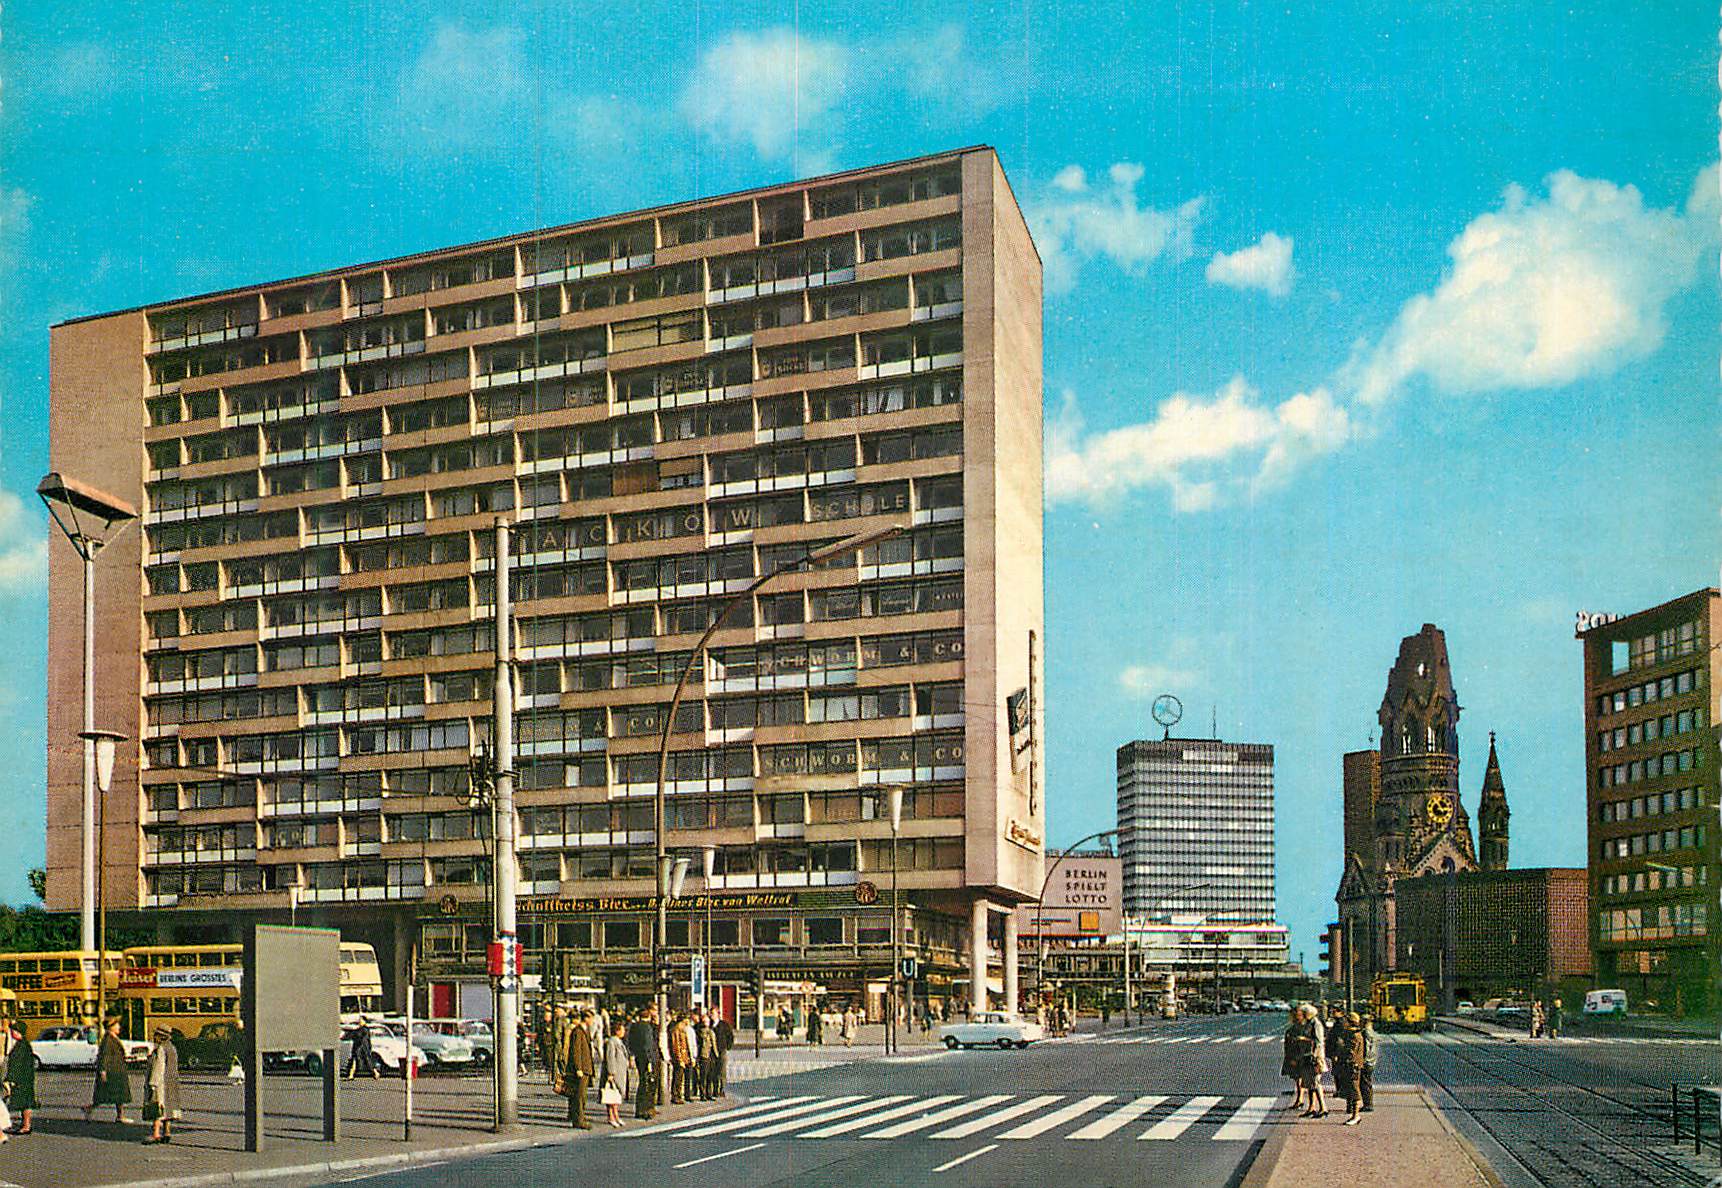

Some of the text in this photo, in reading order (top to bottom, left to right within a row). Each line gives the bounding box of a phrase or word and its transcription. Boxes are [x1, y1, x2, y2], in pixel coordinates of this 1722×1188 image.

[543, 508, 750, 548] ACKOW
[935, 746, 962, 760] CO
[1065, 869, 1107, 879] BERLIN
[1066, 882, 1107, 891] SPIELT
[647, 897, 694, 909] Bliner
[1065, 894, 1107, 904] LOTTO
[903, 959, 914, 977] U
